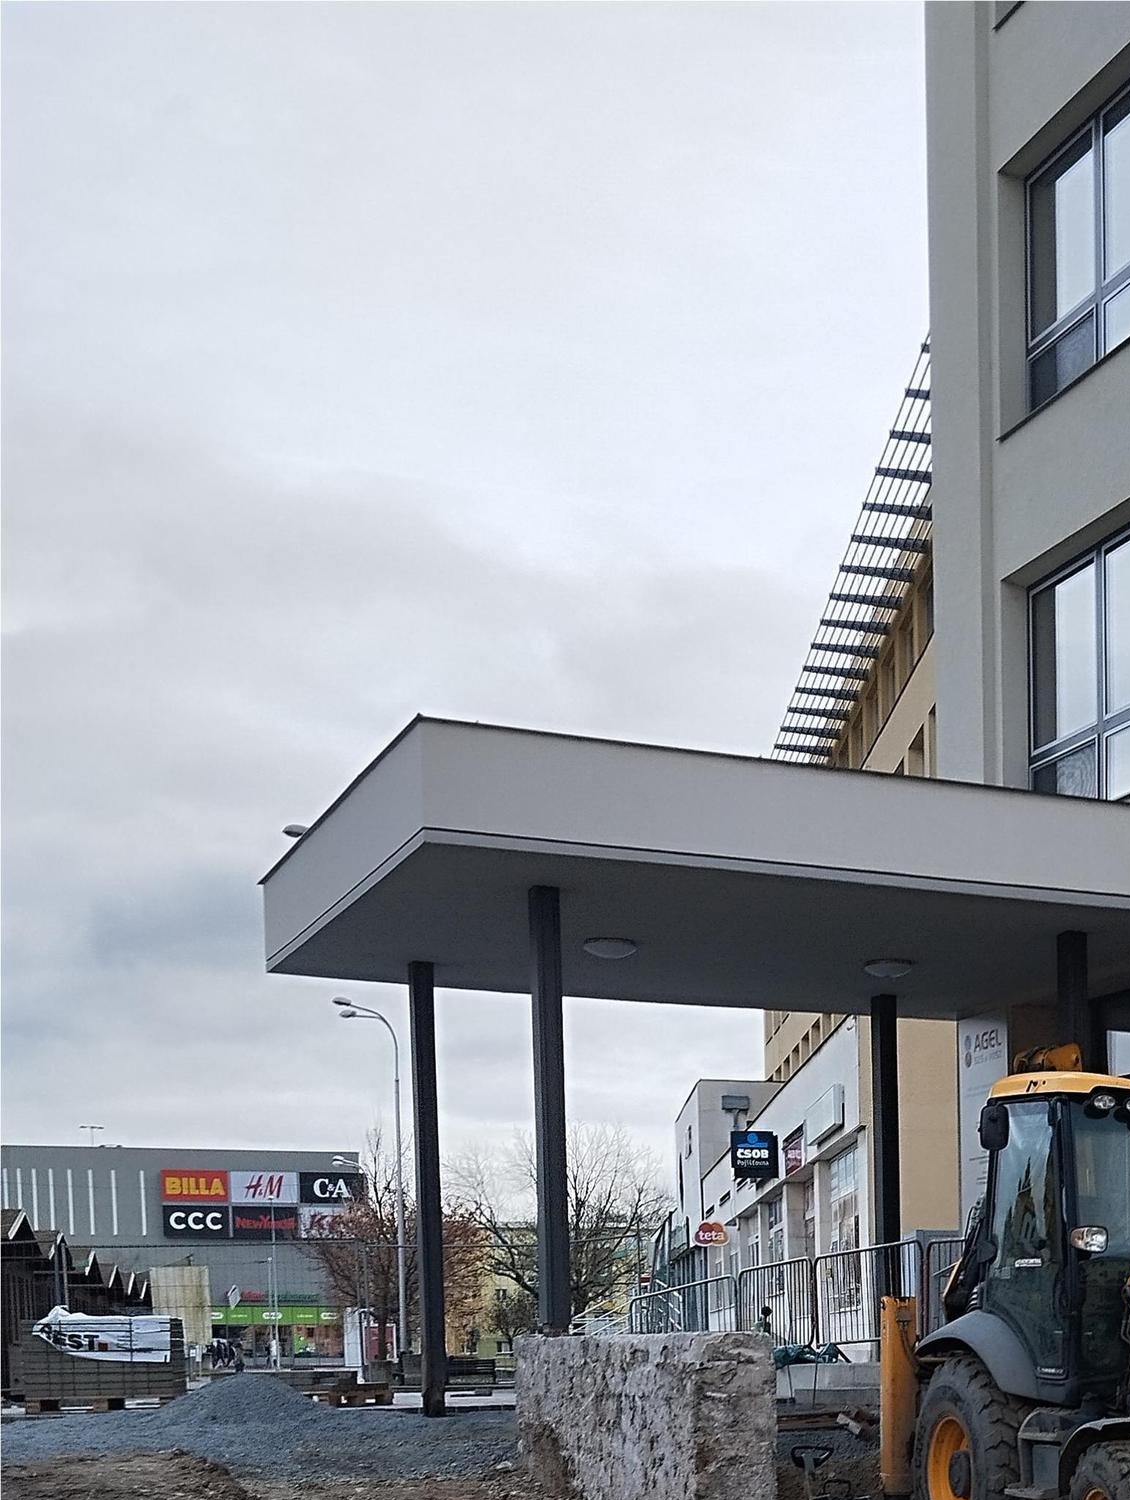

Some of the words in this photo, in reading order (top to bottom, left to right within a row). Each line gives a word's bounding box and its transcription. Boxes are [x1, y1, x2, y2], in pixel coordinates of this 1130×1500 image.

[974, 1028, 1002, 1052] AGEL
[736, 1148, 769, 1158] ČSOB
[165, 1176, 225, 1196] BILLA
[244, 1174, 284, 1199] H&M
[313, 1178, 350, 1198] C&A
[169, 1212, 222, 1231] CCC
[698, 1229, 725, 1241] teta
